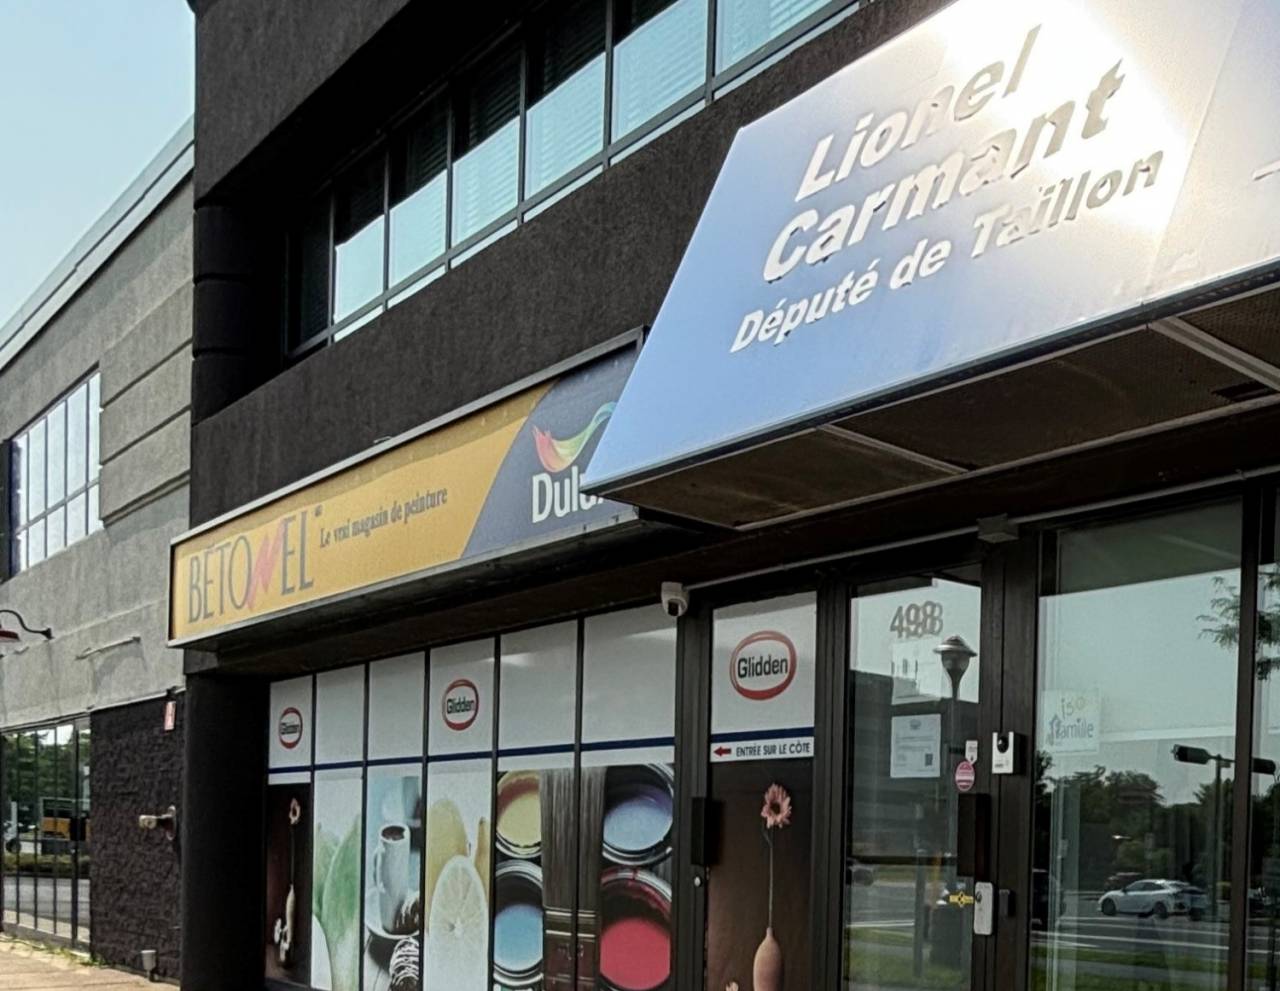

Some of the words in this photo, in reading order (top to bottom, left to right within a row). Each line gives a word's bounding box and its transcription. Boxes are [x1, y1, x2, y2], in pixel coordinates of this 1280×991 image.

[795, 24, 1042, 202] Lionel
[763, 58, 1126, 283] Carmant
[729, 258, 880, 353] Député
[890, 238, 951, 290] de
[971, 150, 1164, 259] Taillon
[390, 500, 402, 523] de
[533, 466, 603, 523] Dul
[737, 654, 788, 679] Glidden
[763, 744, 777, 756] SUR
[778, 744, 787, 755] LE
